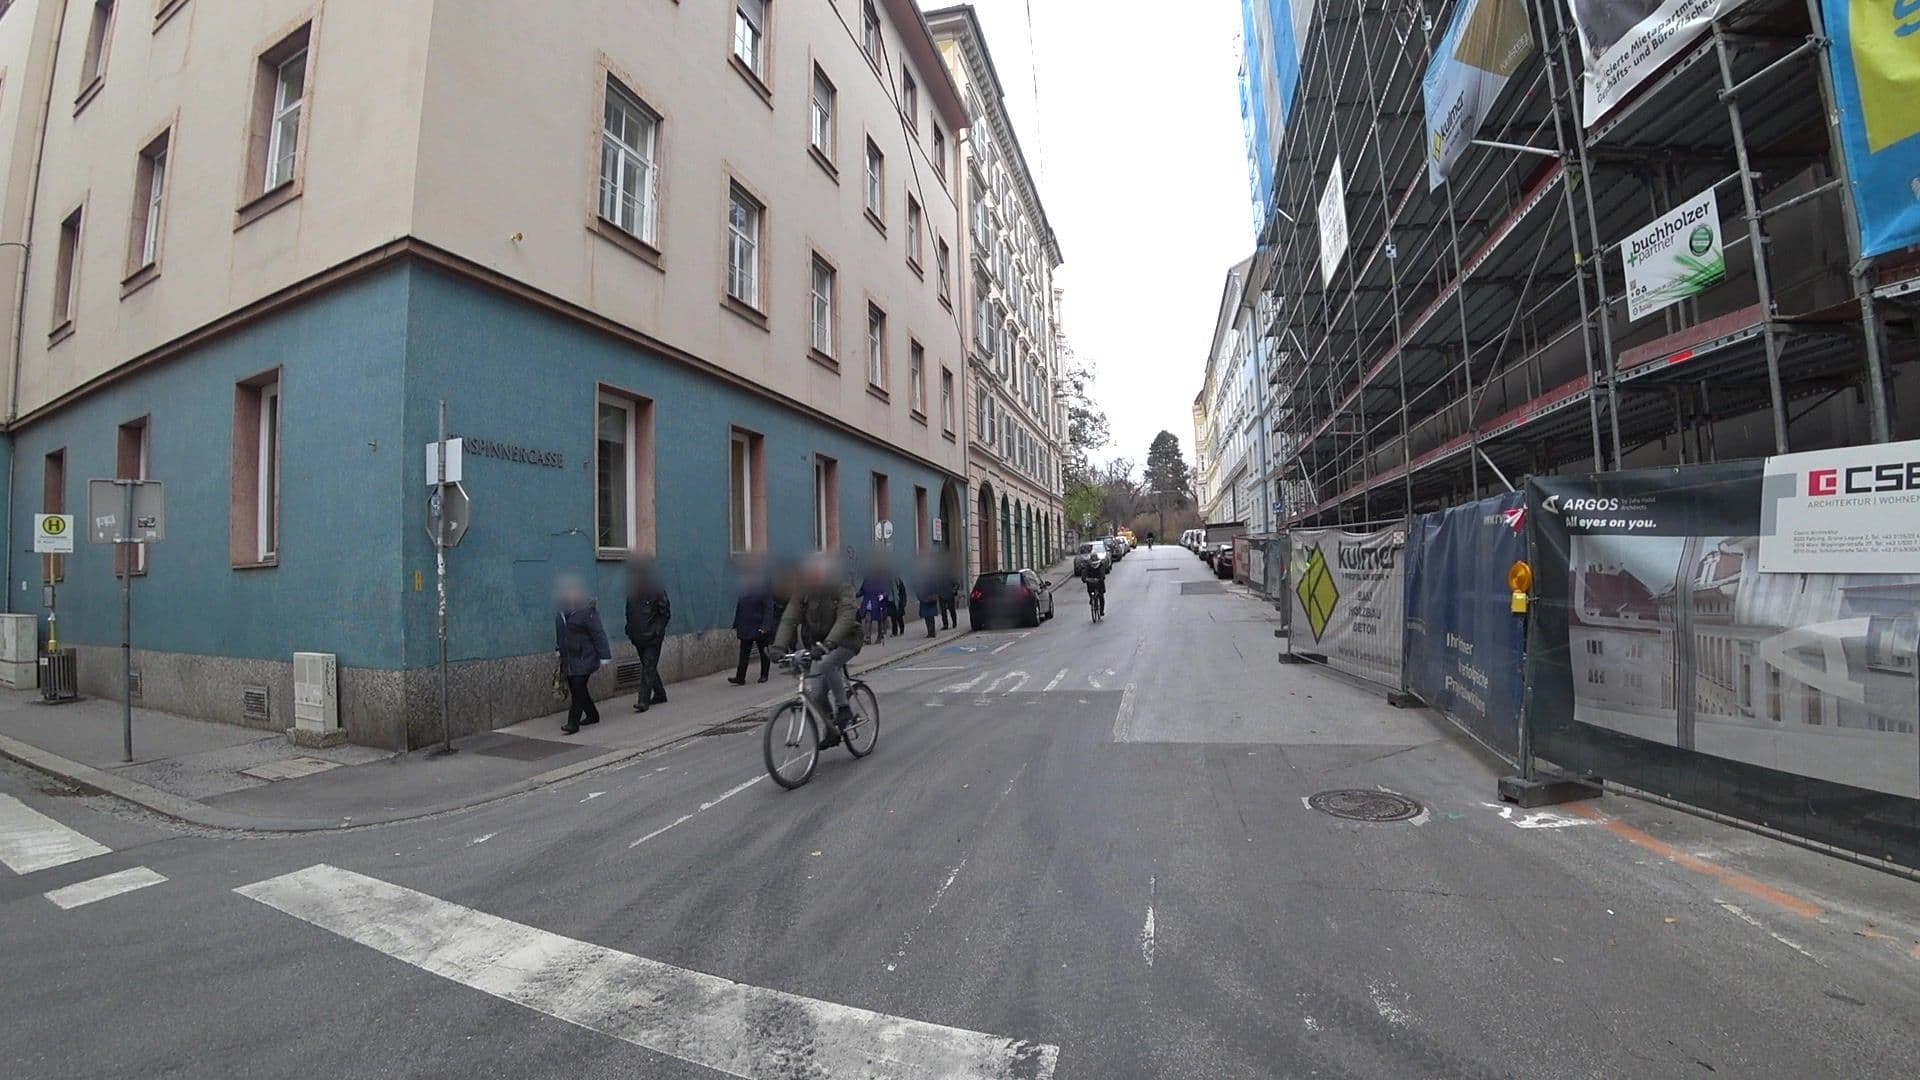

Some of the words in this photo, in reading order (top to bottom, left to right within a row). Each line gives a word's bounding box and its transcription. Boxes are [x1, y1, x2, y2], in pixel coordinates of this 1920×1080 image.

[1630, 0, 1697, 54] Mietapartme
[1633, 45, 1651, 66] und
[1631, 201, 1710, 255] buchholzer
[1563, 498, 1619, 511] ARGOS
[1807, 497, 1871, 509] ARCHITEKTUR
[48, 519, 60, 532] H
[1566, 515, 1578, 528] All
[1579, 518, 1607, 530] eyes
[1609, 519, 1625, 528] on
[1628, 518, 1657, 530] you.
[1352, 621, 1377, 635] BETON
